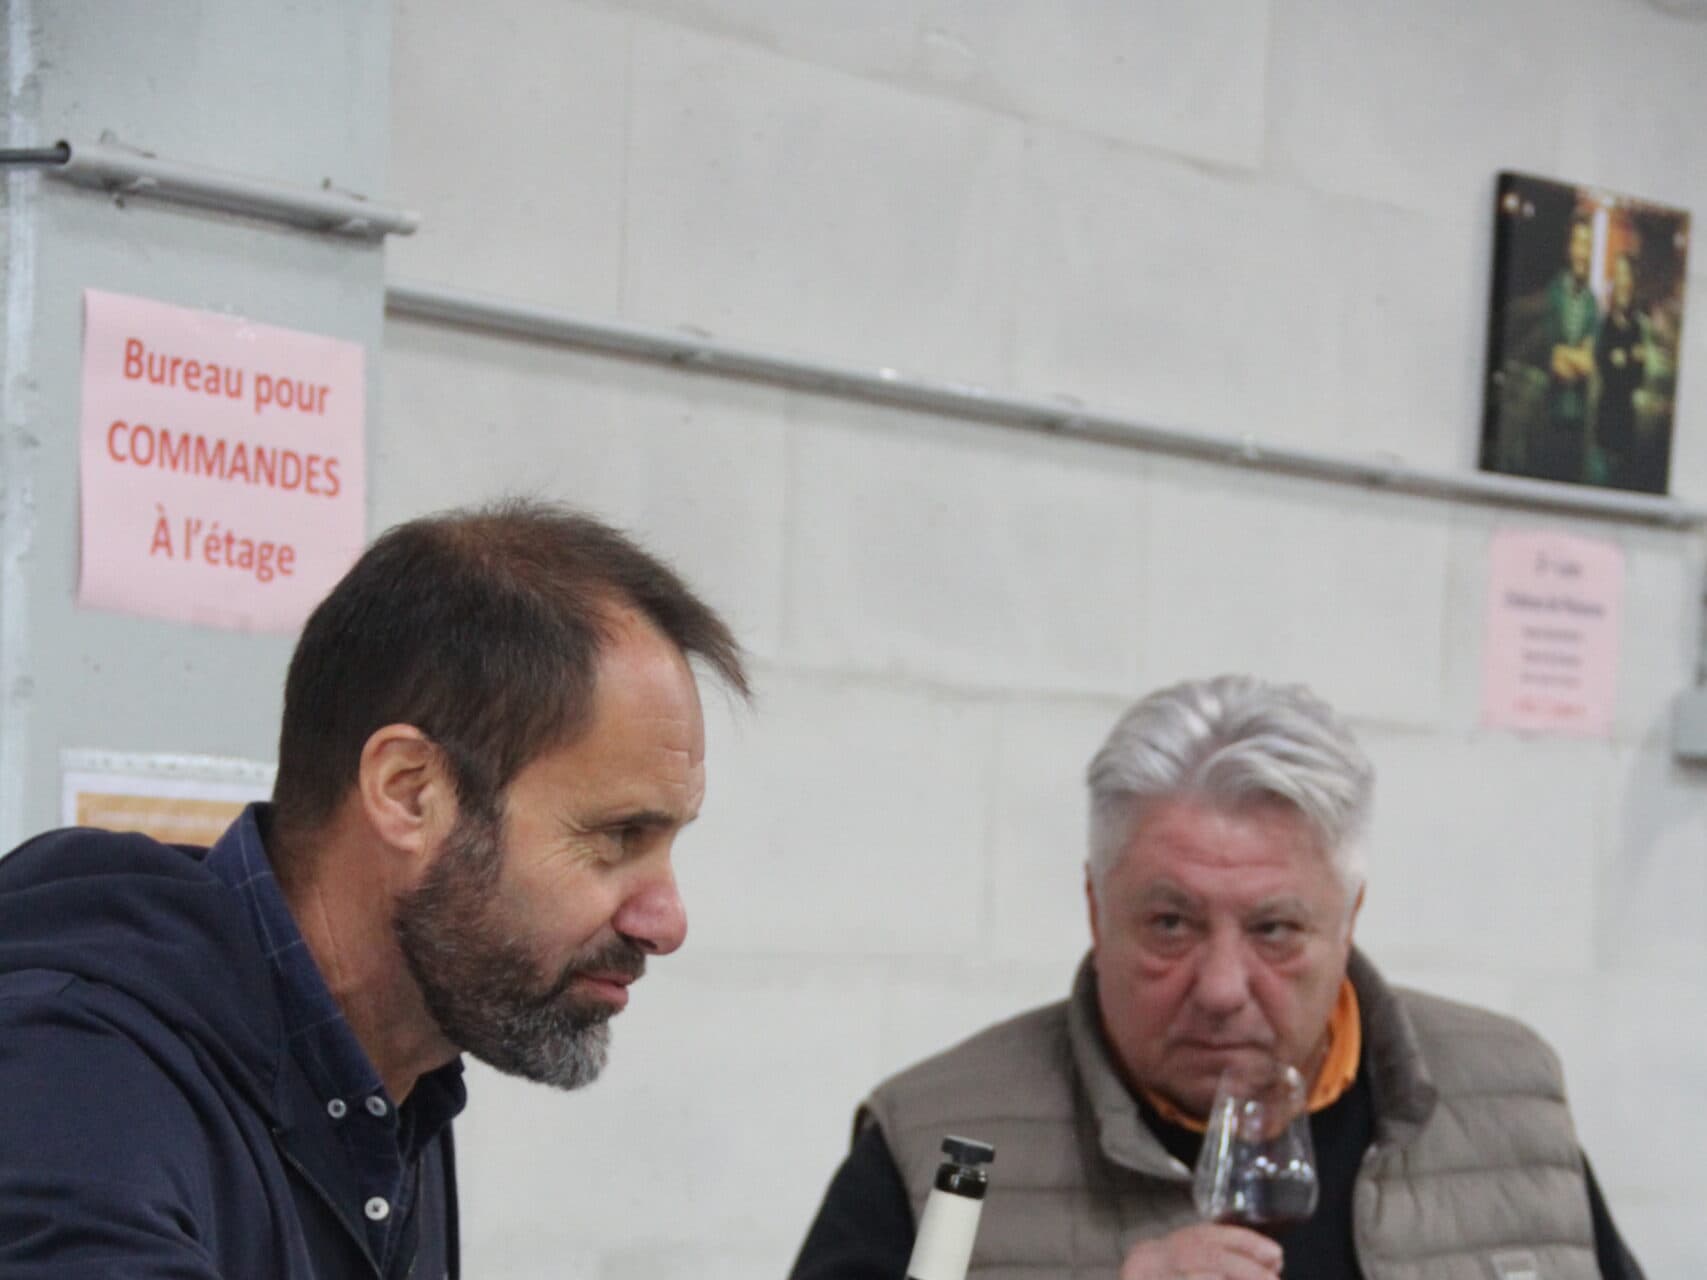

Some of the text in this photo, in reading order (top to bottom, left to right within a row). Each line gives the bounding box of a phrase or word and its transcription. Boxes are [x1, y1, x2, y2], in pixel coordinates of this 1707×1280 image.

[122, 337, 330, 414] Bureau pour
[107, 420, 341, 497] COMMANDES
[150, 503, 173, 558] À
